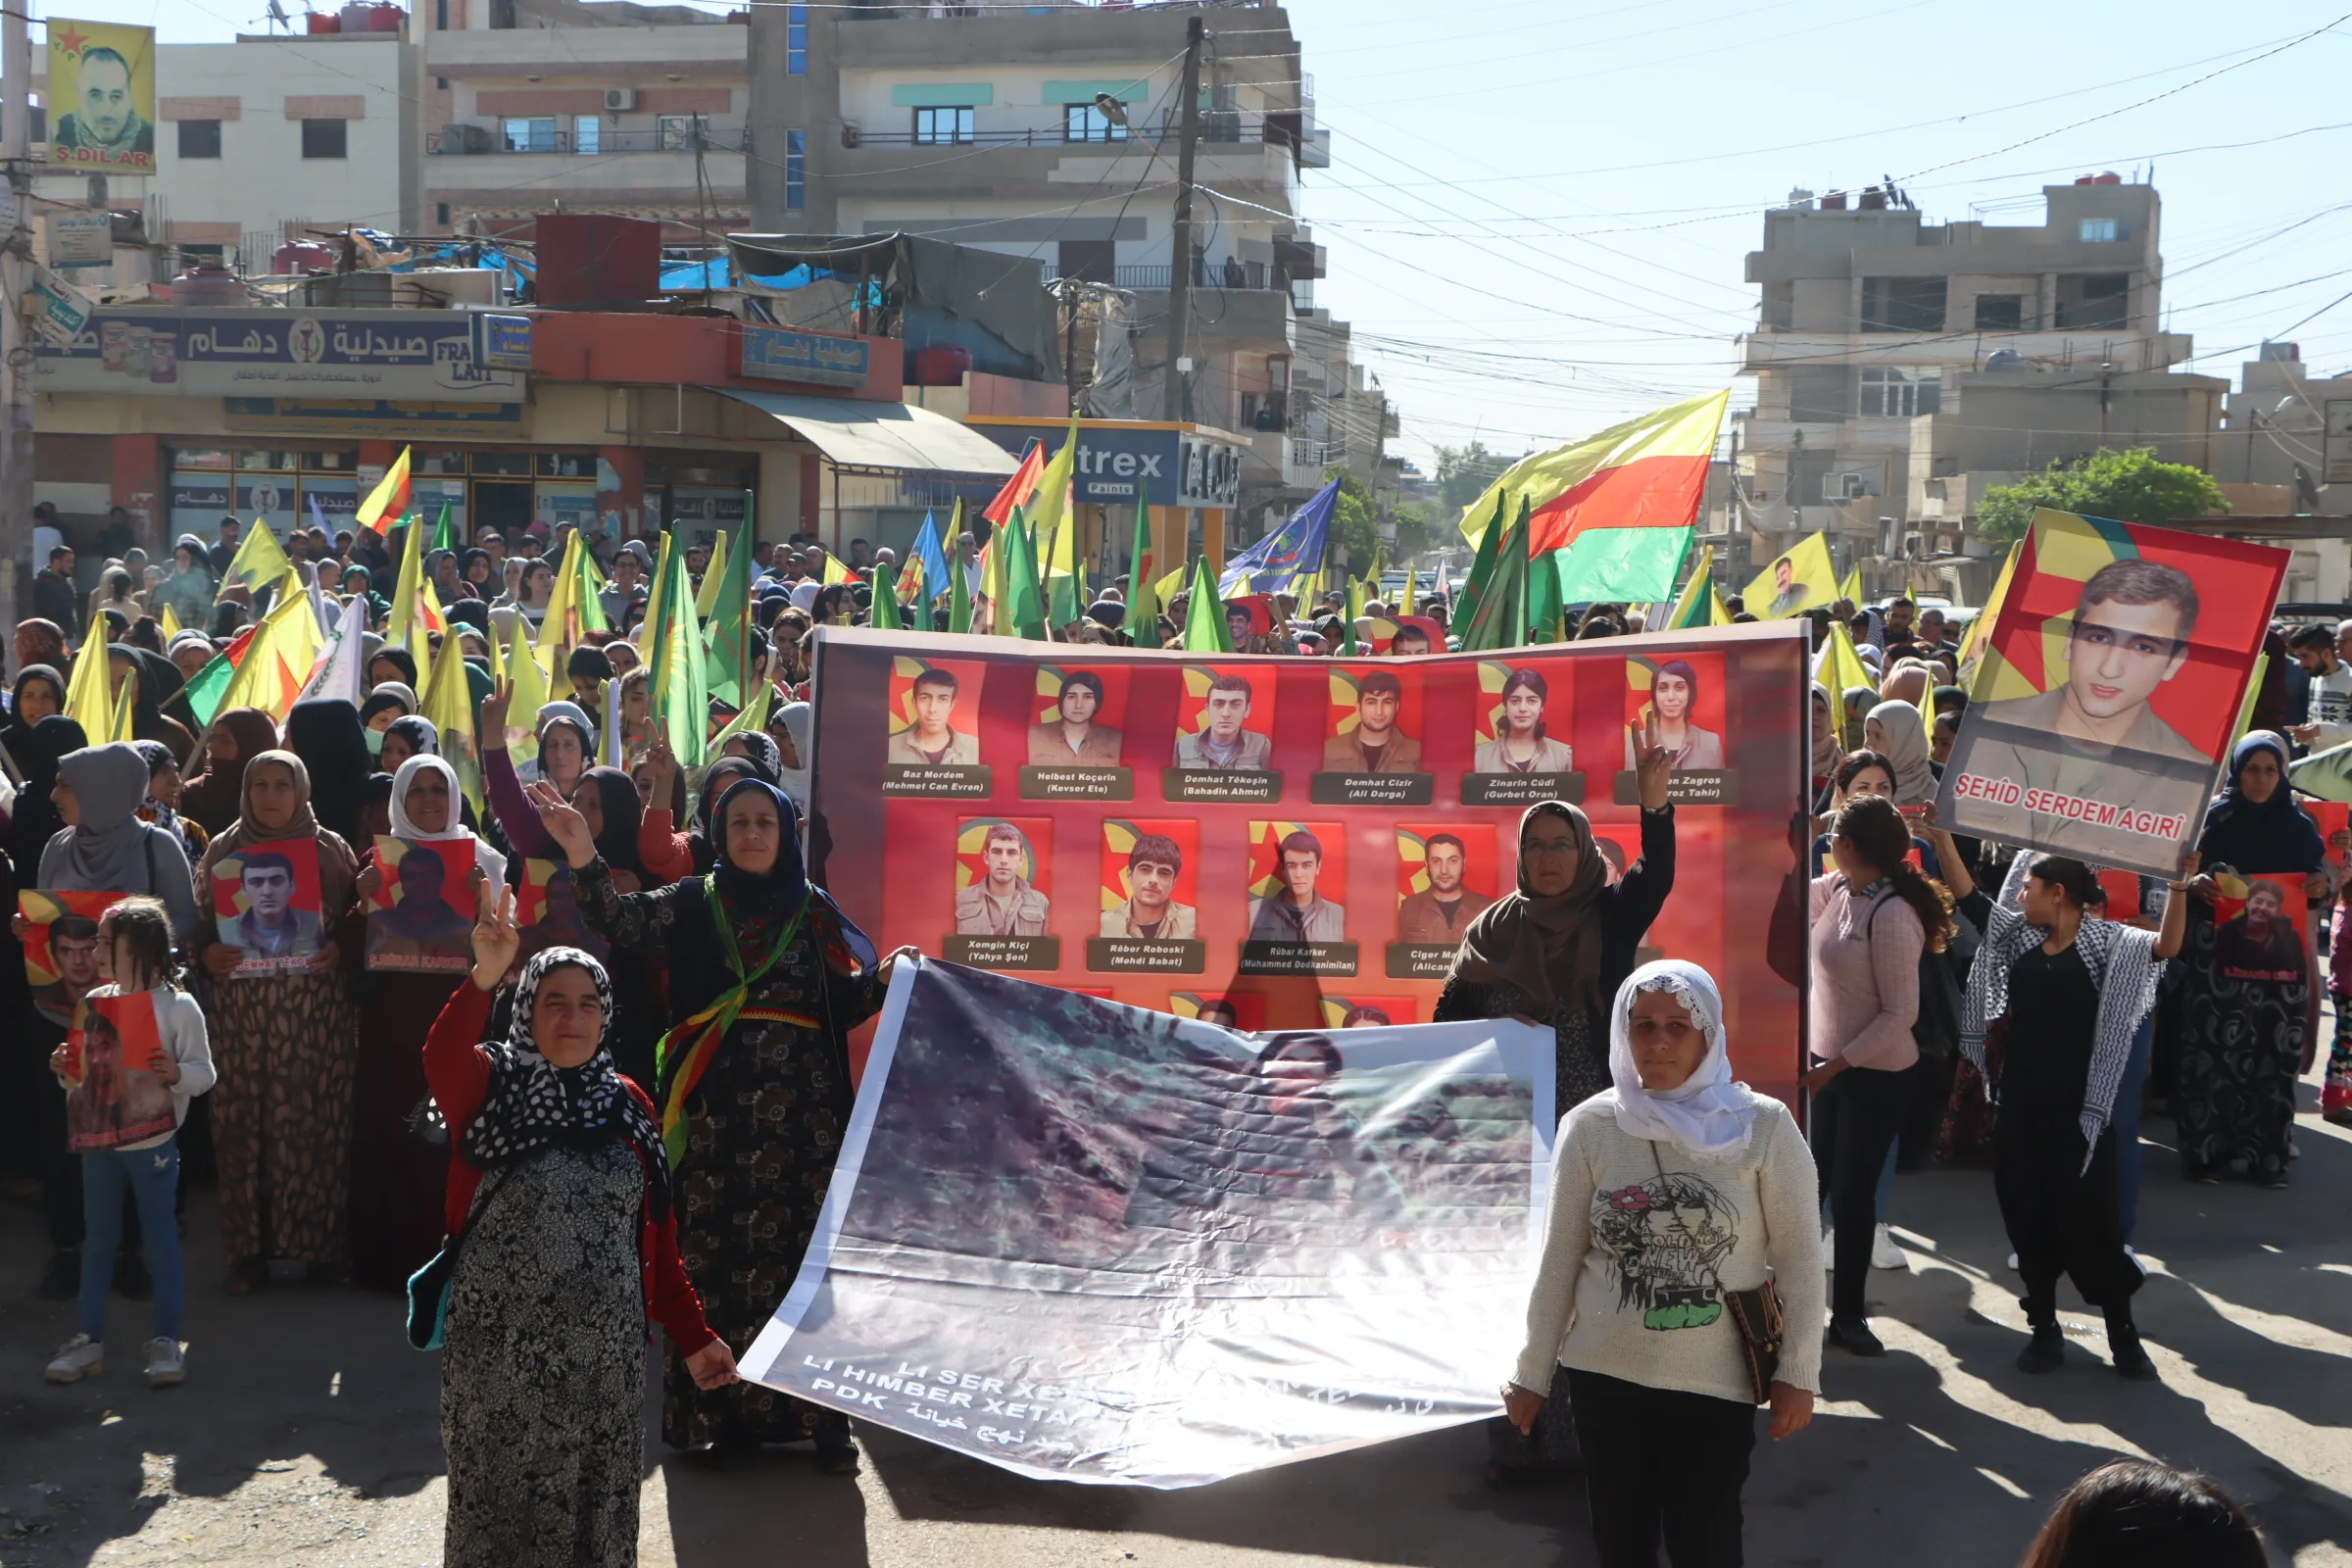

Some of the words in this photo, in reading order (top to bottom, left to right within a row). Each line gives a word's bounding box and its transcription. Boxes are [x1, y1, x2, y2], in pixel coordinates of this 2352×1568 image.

[188, 325, 278, 359] دهام
[333, 322, 428, 363] صيدلية
[436, 343, 471, 362] FRA
[765, 333, 811, 364] دهام
[813, 338, 861, 367] صيدلية
[1051, 445, 1162, 478] trex
[174, 489, 226, 506] دهام
[1038, 772, 1075, 781] Helbest
[1185, 774, 1224, 783] Demhat
[1683, 776, 1721, 786] Zagros
[882, 781, 926, 791] (Mehmet
[951, 782, 984, 792] Evren)
[1047, 784, 1085, 793] (Kevser
[1088, 785, 1108, 794] Ete)
[1231, 787, 1268, 797] Ahmet)
[1348, 790, 1368, 799] (Ali
[1370, 790, 1406, 800] Darga)
[1485, 790, 1526, 800] (Gurbet
[1529, 790, 1558, 800] Oran)
[1689, 789, 1721, 798] Tahir)
[1955, 774, 2021, 806] ŞEHÎD
[2024, 789, 2116, 825] SERDEM
[2118, 809, 2184, 840] AGIRÎ
[1110, 944, 1141, 953] Rêber
[1298, 948, 1327, 957] Karker
[968, 952, 1003, 962] (Yahya
[1005, 953, 1028, 963] Şen)
[1410, 950, 1439, 960] Ciger
[1111, 956, 1146, 966] (Mehdi
[1149, 957, 1183, 967] Babat)
[1241, 959, 1292, 969] (Muhammed
[1641, 1246, 1700, 1272] NEW
[898, 1361, 928, 1379] LI
[937, 1369, 1004, 1396] SER
[803, 1354, 834, 1372] LI
[842, 1363, 973, 1409] HIMBER
[981, 1397, 1070, 1427] XETA
[810, 1377, 889, 1411] PDK
[905, 1401, 968, 1431] خيانة
[976, 1424, 1024, 1446] نهج
